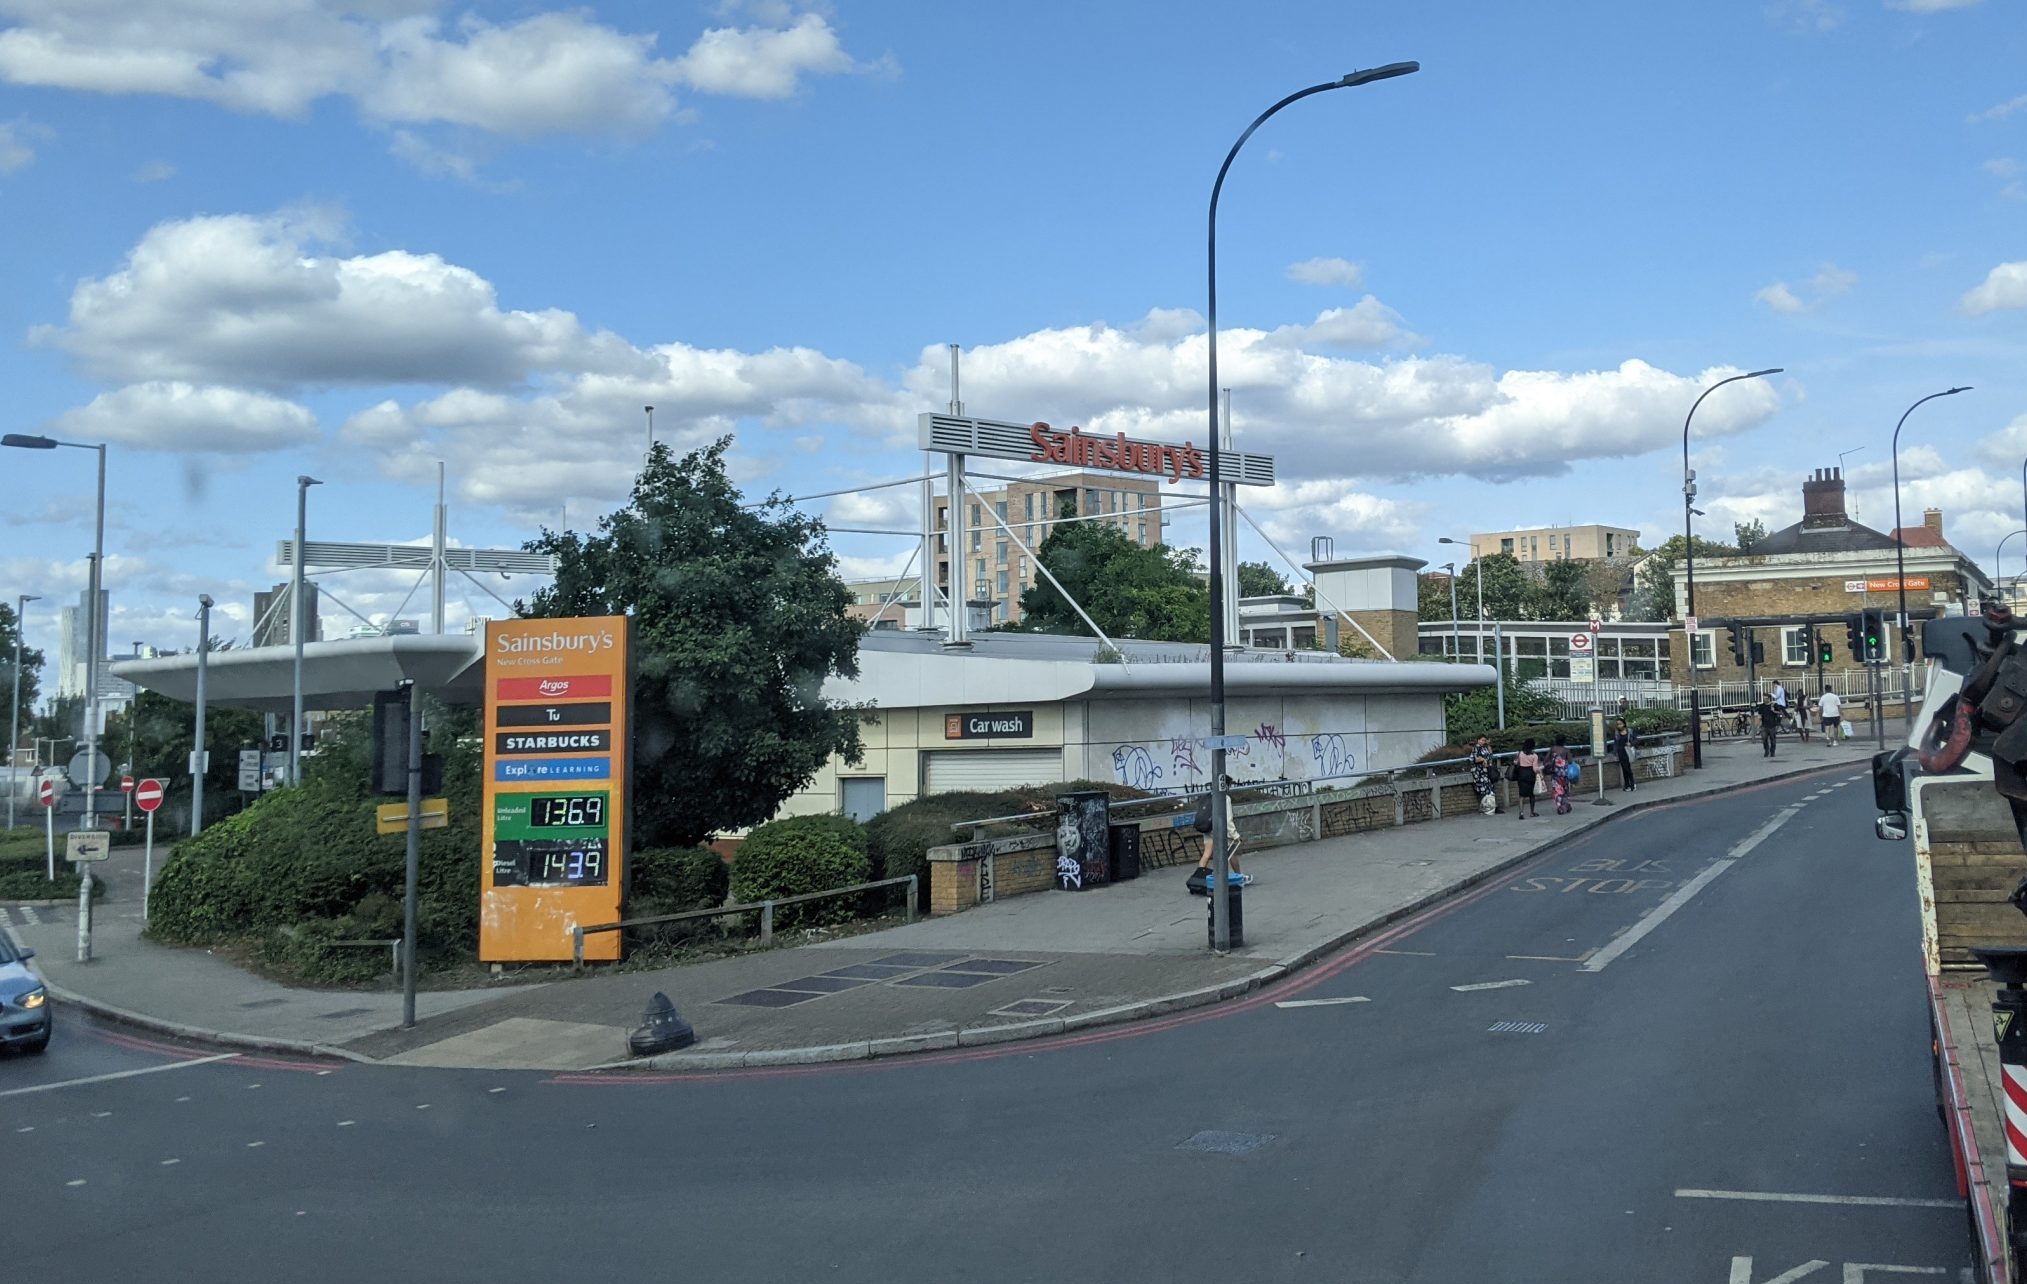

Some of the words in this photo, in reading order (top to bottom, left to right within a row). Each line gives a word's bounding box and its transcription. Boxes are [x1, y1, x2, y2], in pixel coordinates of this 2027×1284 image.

[1030, 421, 1204, 484] Sainsbury's
[1887, 580, 1908, 588] Cros
[497, 630, 614, 654] Sainsbury's
[497, 658, 516, 666] New
[517, 657, 540, 665] Cross
[542, 656, 564, 665] Gate
[539, 680, 569, 692] Argos
[546, 708, 560, 721] Tu
[969, 718, 990, 733] Car
[991, 716, 1023, 732] wash
[506, 735, 600, 750] STARBUCKS
[505, 764, 548, 776] Explre
[549, 765, 600, 774] LEARNING
[1567, 858, 1673, 873] BUS
[1510, 877, 1673, 894] STOP
